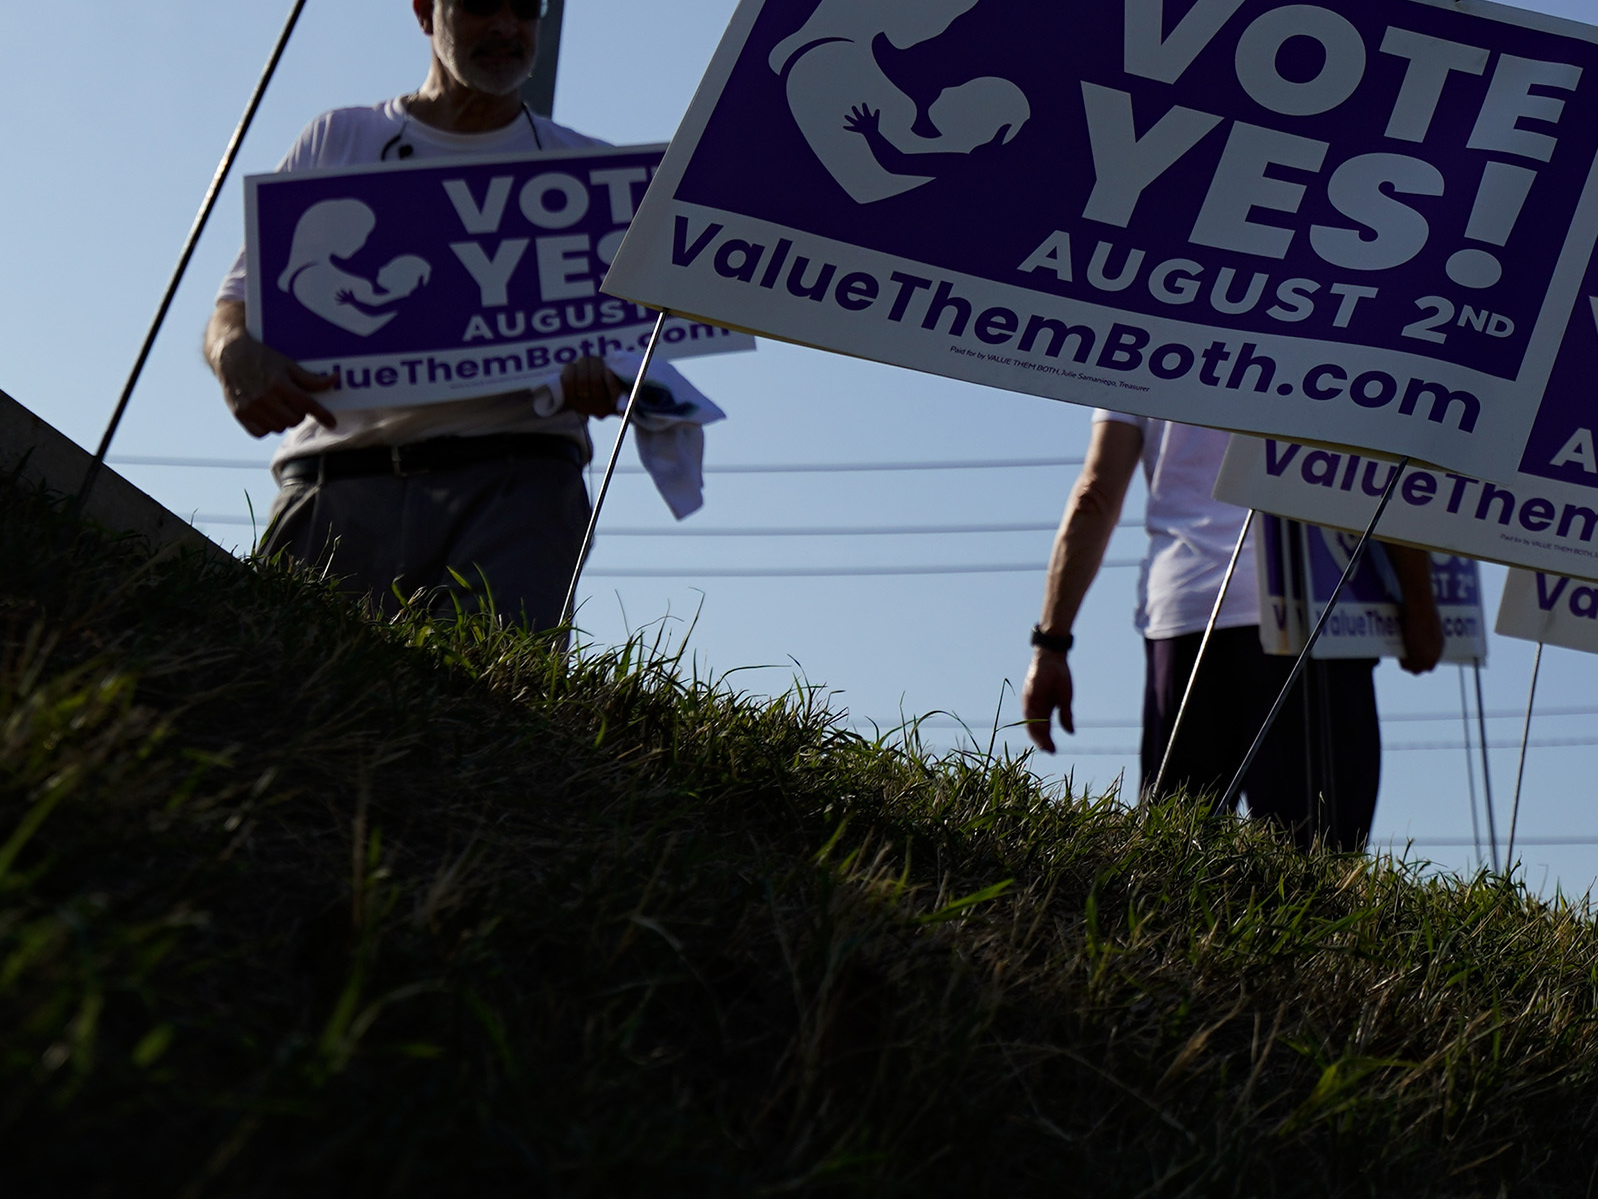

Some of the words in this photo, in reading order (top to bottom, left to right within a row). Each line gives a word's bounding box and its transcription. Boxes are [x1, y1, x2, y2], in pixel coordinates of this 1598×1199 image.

[440, 165, 658, 236] VOT
[1079, 79, 1537, 289] YES!
[668, 213, 1483, 434] ValueThemBoth.com
[1017, 230, 1383, 330] AUGUST
[1400, 294, 1516, 349] 2ND
[950, 345, 966, 355] Paid
[966, 349, 976, 357] for
[977, 352, 986, 360] by
[987, 354, 1012, 365] VALUE
[1013, 359, 1036, 370] THEM
[1119, 380, 1151, 392] Treasurer
